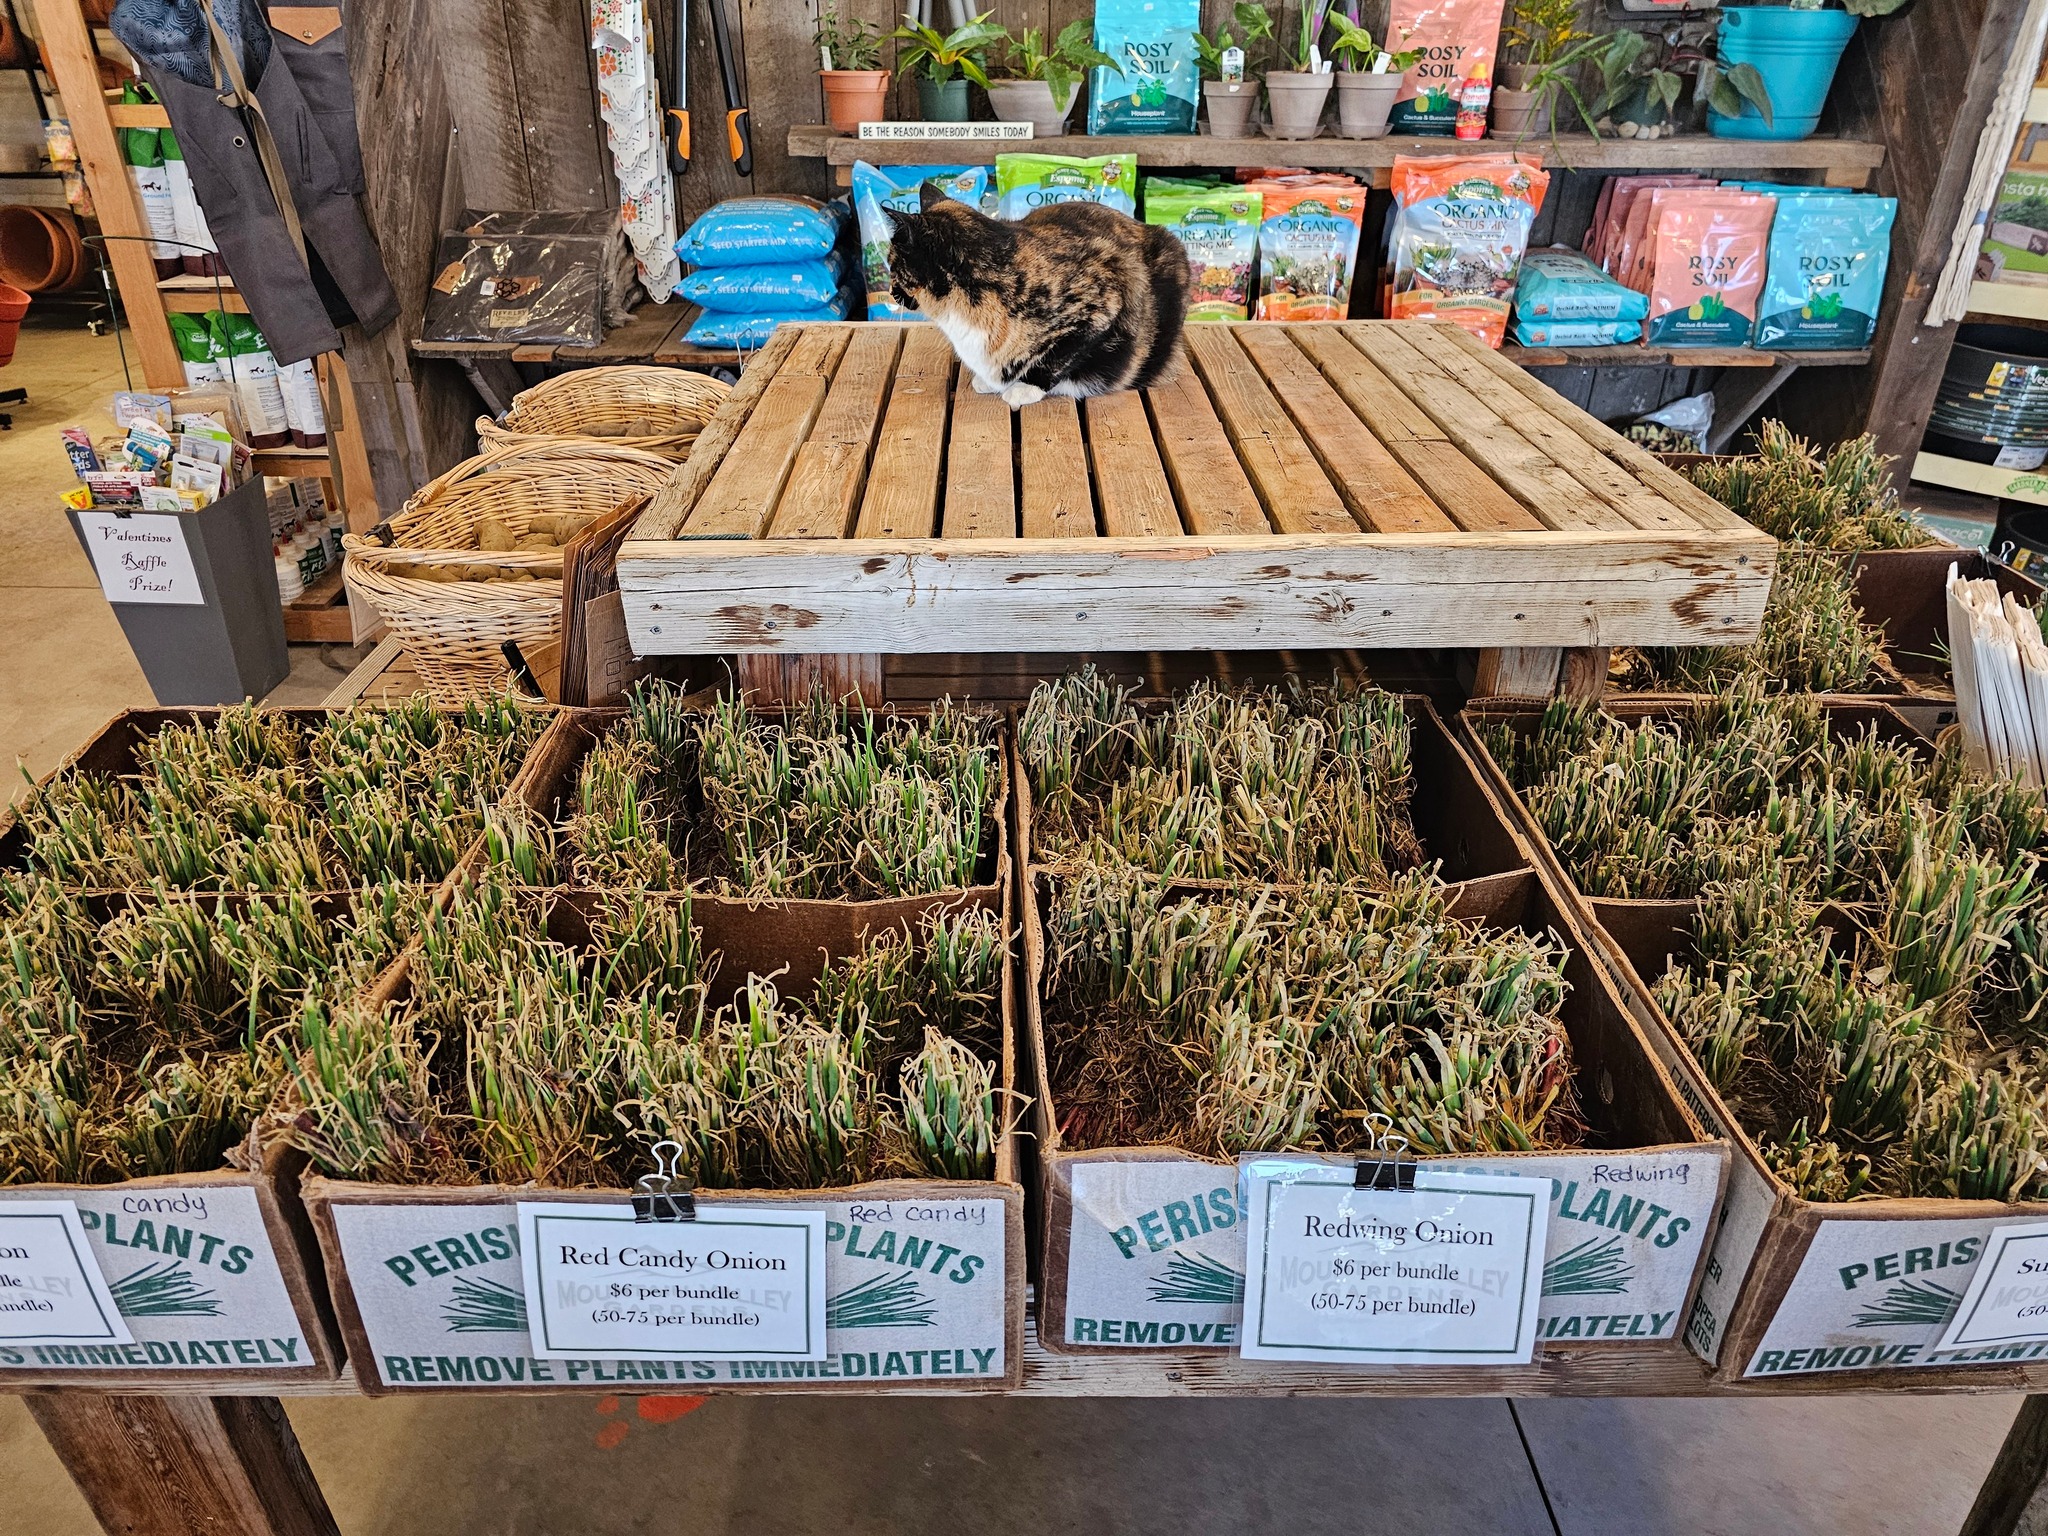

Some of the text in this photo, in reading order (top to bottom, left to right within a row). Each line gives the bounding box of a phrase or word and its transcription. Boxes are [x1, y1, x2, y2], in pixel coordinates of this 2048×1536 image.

[1124, 42, 1173, 57] ROSY
[1418, 46, 1467, 60] ROSY
[1129, 60, 1170, 74] SOIL
[1417, 64, 1458, 78] SOIL
[863, 126, 1028, 138] BE THE REASON SOMEBODY SMILES TODAY
[1050, 174, 1087, 184] Espoma
[1434, 203, 1516, 220] ORGANIC
[1278, 219, 1345, 233] ORGANIC
[1441, 219, 1485, 230] CACTUS
[712, 241, 732, 250] SEED
[734, 239, 769, 249] STARTER
[770, 238, 786, 246] MIX
[1187, 241, 1213, 250] TTING
[1285, 233, 1319, 242] CACTUS
[1688, 255, 1738, 270] ROSY
[1799, 255, 1857, 271] ROSY
[1804, 273, 1850, 288] SOIL
[718, 286, 738, 294] SEED
[1436, 298, 1505, 312] ORGANIC GARDENING
[98, 526, 172, 542] Valentines
[121, 551, 167, 571] Raffle
[129, 575, 173, 591] Prize!
[1680, 1082, 1723, 1140] PATTERSO
[1593, 1163, 1690, 1185] Redwing
[850, 1204, 894, 1223] Red
[1108, 1186, 1240, 1260] PERIS
[1304, 1215, 1494, 1246] Redwing Onion
[77, 1208, 254, 1275] PLANTS
[383, 1221, 985, 1288] PERIS PLANTS
[559, 1246, 787, 1272] Red Candy Onion
[1333, 1258, 1459, 1280] $6 per bundle
[1838, 1236, 1983, 1291] PERIS
[610, 1283, 739, 1300] $6 per bundle
[1311, 1293, 1476, 1316] (50-75 per bundle)
[592, 1309, 760, 1327] (50-75 per bundle)
[1073, 1317, 1235, 1344] REMOVE
[32, 1337, 298, 1365] IMMEDIATELY
[1753, 1344, 1924, 1373] REMOVE
[383, 1347, 997, 1382] REMOVE PLANTS IMMEDIATELY
